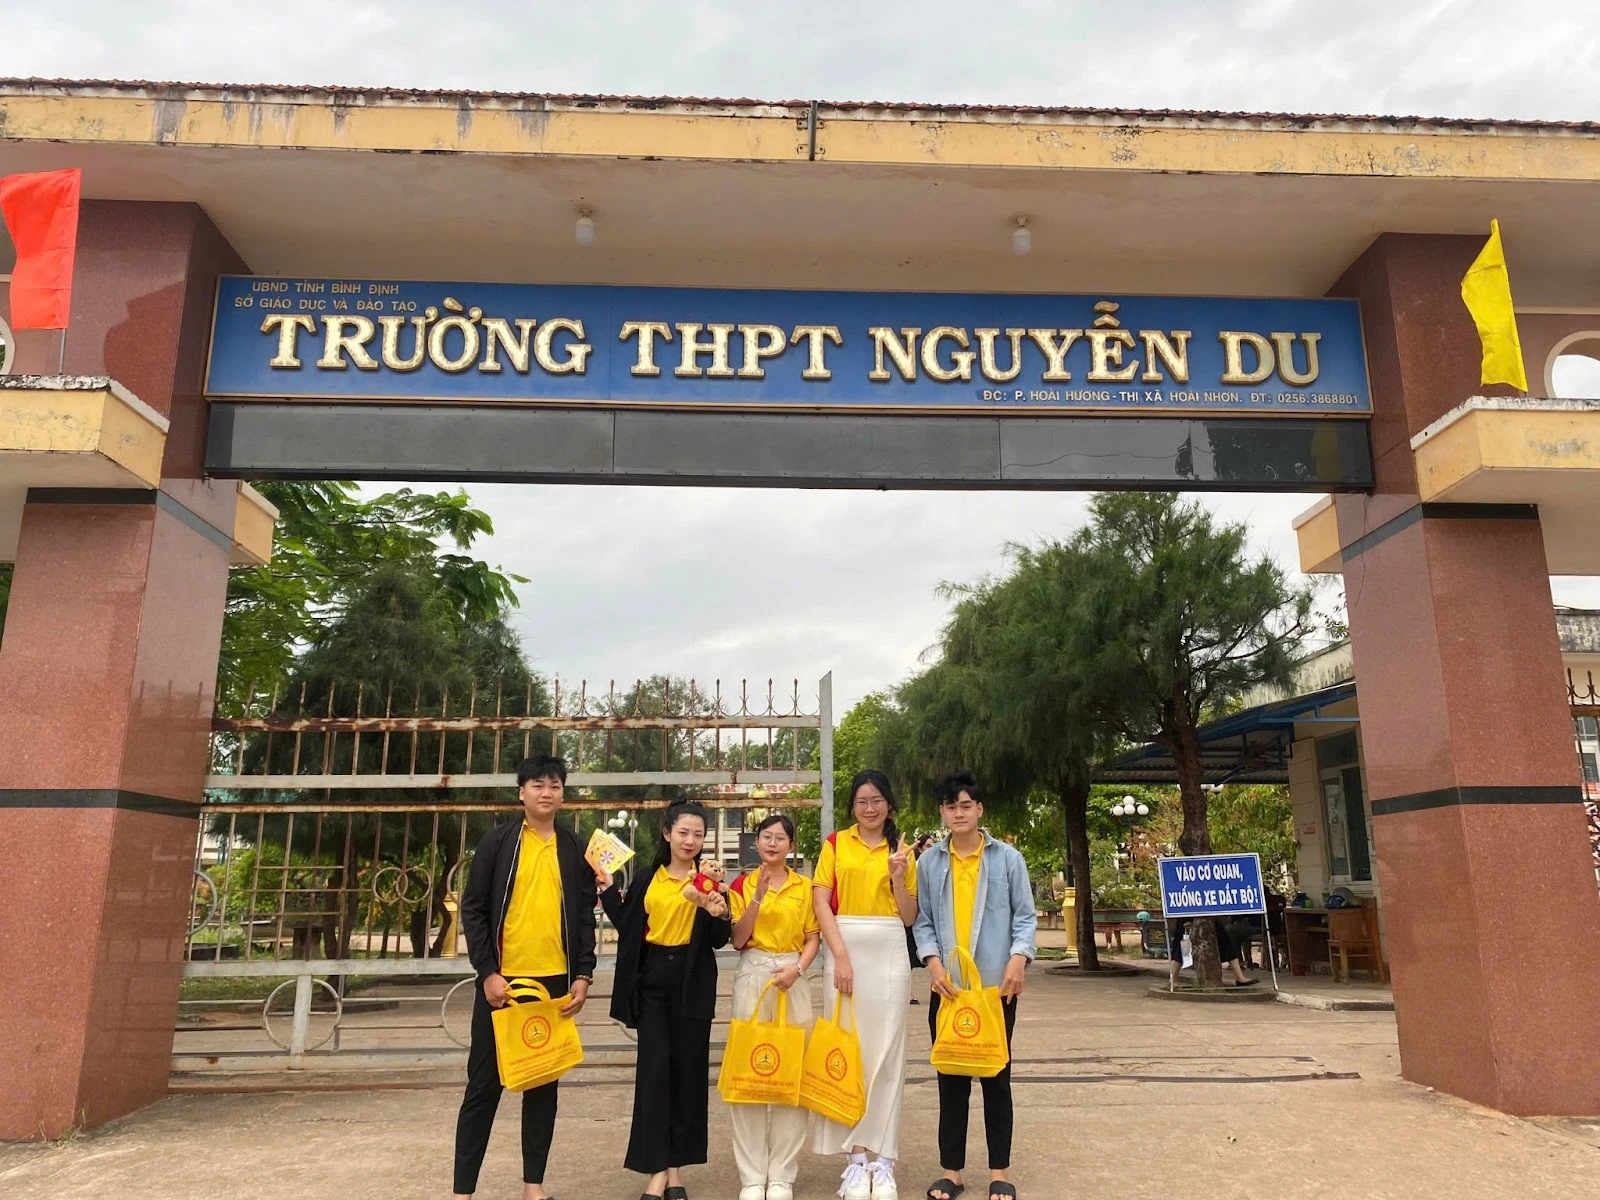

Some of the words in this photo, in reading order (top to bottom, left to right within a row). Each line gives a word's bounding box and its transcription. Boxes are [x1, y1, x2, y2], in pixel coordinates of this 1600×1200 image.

[252, 282, 288, 293] UBND
[295, 279, 325, 294] TỈNH
[332, 281, 361, 294] BÌNH
[368, 284, 399, 296] ĐỊNH
[234, 294, 254, 308] SỞ
[259, 296, 292, 309] GIÁO
[333, 298, 348, 310] VÀ
[356, 298, 384, 311] ĐÀO
[391, 300, 417, 313] TẠO
[260, 296, 593, 375] TRƯỜNG
[618, 321, 843, 380] THPT
[867, 301, 1191, 384] NGUYỄN
[1218, 331, 1322, 386] DU
[983, 390, 1007, 401] ĐC:
[1015, 391, 1026, 401] P.
[1030, 388, 1060, 401] HOÀI
[1145, 389, 1163, 402] XÃ
[1169, 390, 1199, 402] HOÀI
[1204, 391, 1243, 402] NHƠN.
[1251, 392, 1272, 403] ĐT:
[1277, 393, 1358, 404] 0256.3868801
[1175, 862, 1196, 882] VÀO
[1197, 862, 1211, 880] CƠ
[1213, 863, 1244, 882] QUAN,
[1168, 885, 1202, 907] XUỐNG
[1204, 890, 1217, 906] XE
[1218, 883, 1238, 905] DẮT
[1240, 884, 1259, 908] BỘ!
